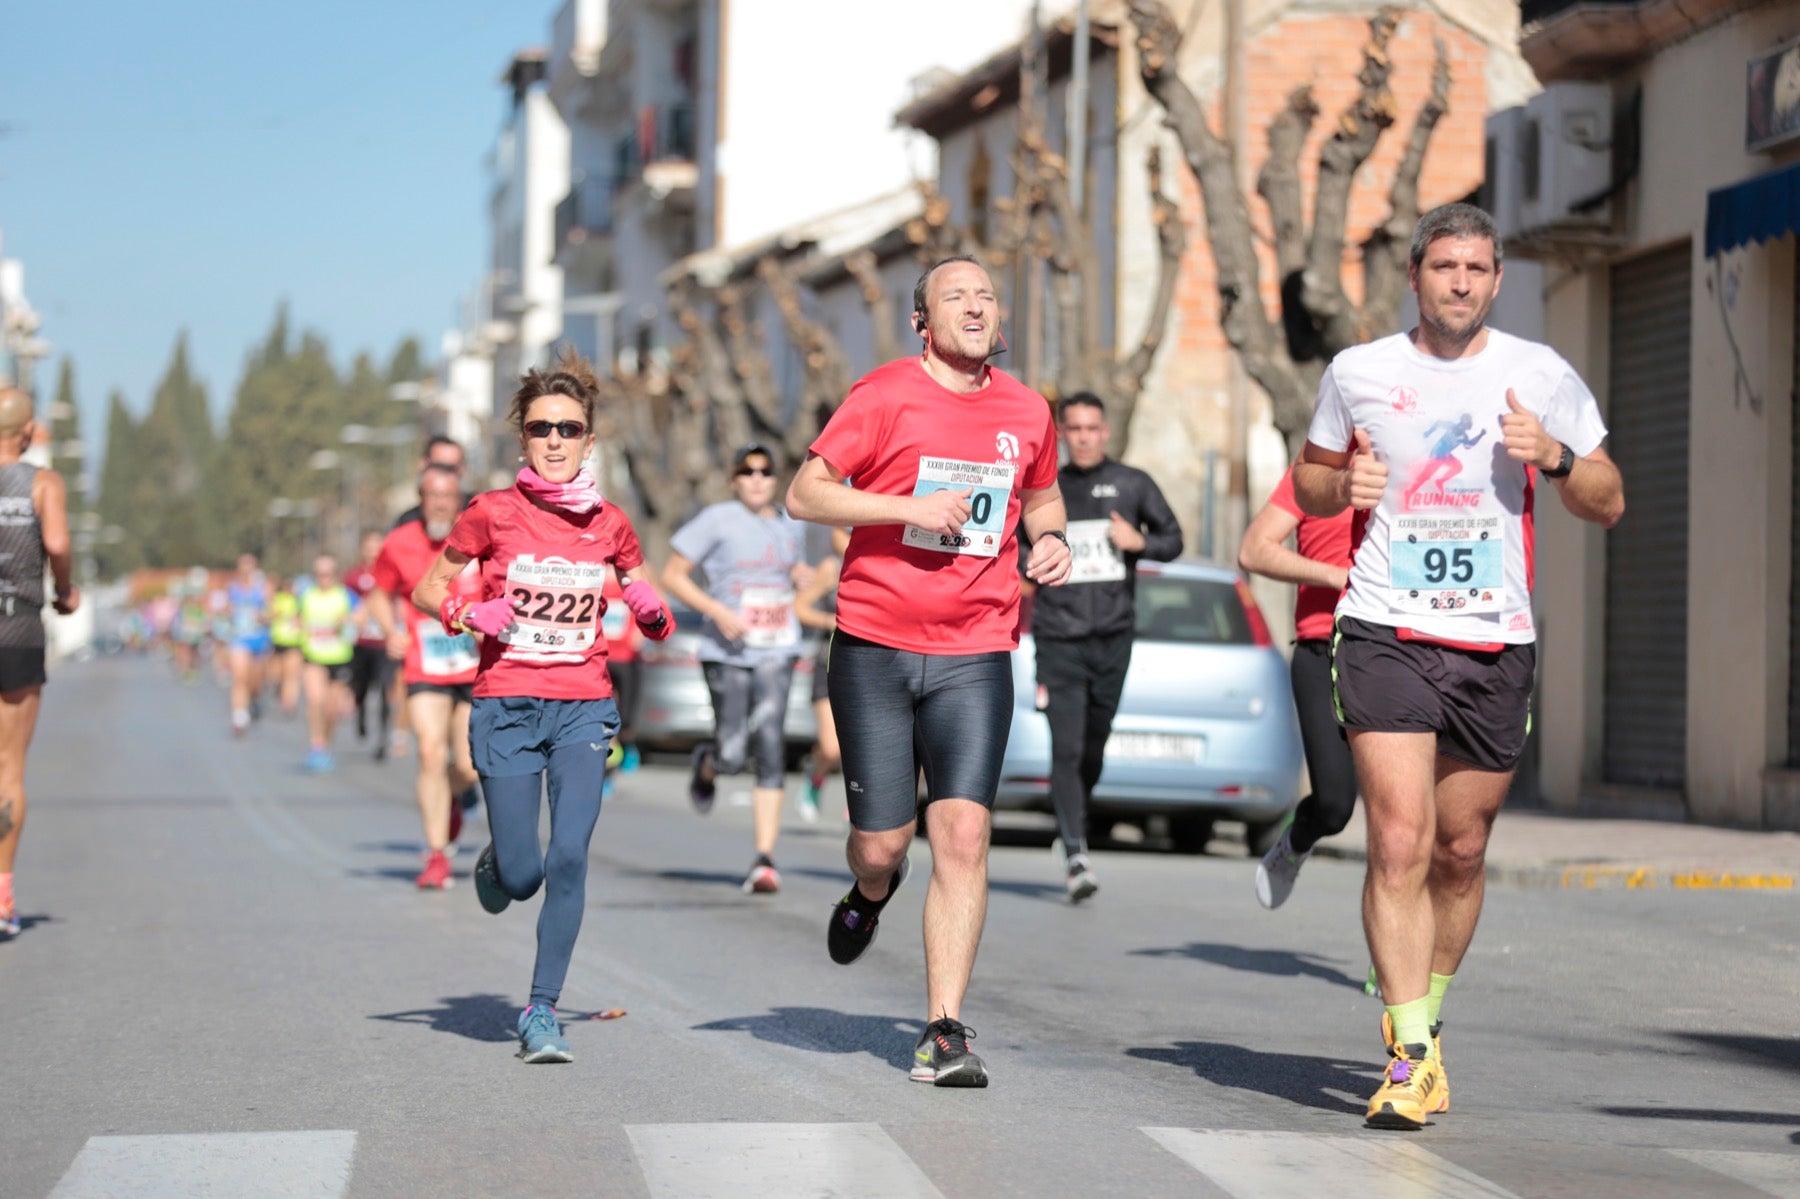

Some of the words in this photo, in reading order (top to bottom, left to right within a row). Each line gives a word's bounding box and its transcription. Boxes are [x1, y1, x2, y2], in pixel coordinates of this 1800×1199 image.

[945, 462, 960, 472] GRAN
[960, 463, 982, 475] PREMIO
[982, 466, 990, 476] DE
[991, 467, 1009, 477] FONDO
[1412, 493, 1480, 507] RUNNING
[1419, 519, 1437, 529] GRAN
[1439, 519, 1465, 529] PREMIO
[1467, 519, 1476, 528] DE
[1477, 517, 1498, 528] FONDO
[534, 564, 549, 574] GRAN
[551, 566, 572, 575] PREMIO
[574, 568, 581, 576] DE
[583, 569, 600, 577] FONDO
[1424, 548, 1473, 583] 95
[512, 588, 594, 623] 2222
